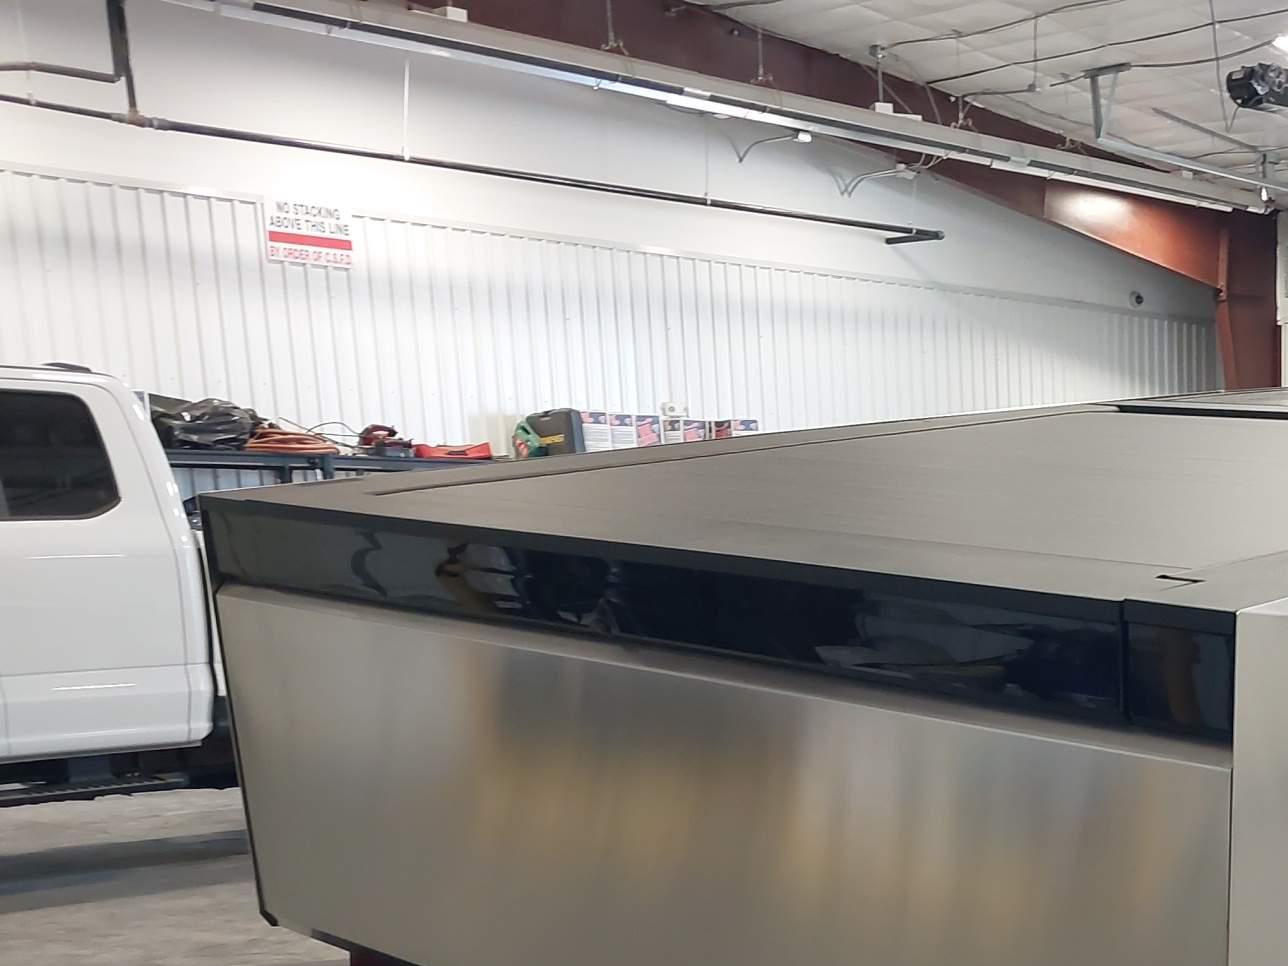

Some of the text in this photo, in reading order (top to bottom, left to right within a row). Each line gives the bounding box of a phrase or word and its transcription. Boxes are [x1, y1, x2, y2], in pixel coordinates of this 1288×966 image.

[275, 201, 340, 220] NO STACKING
[270, 216, 350, 236] ABOVE THIS LINE
[270, 245, 280, 257] BY
[283, 247, 309, 261] ORDER
[311, 250, 322, 262] OF
